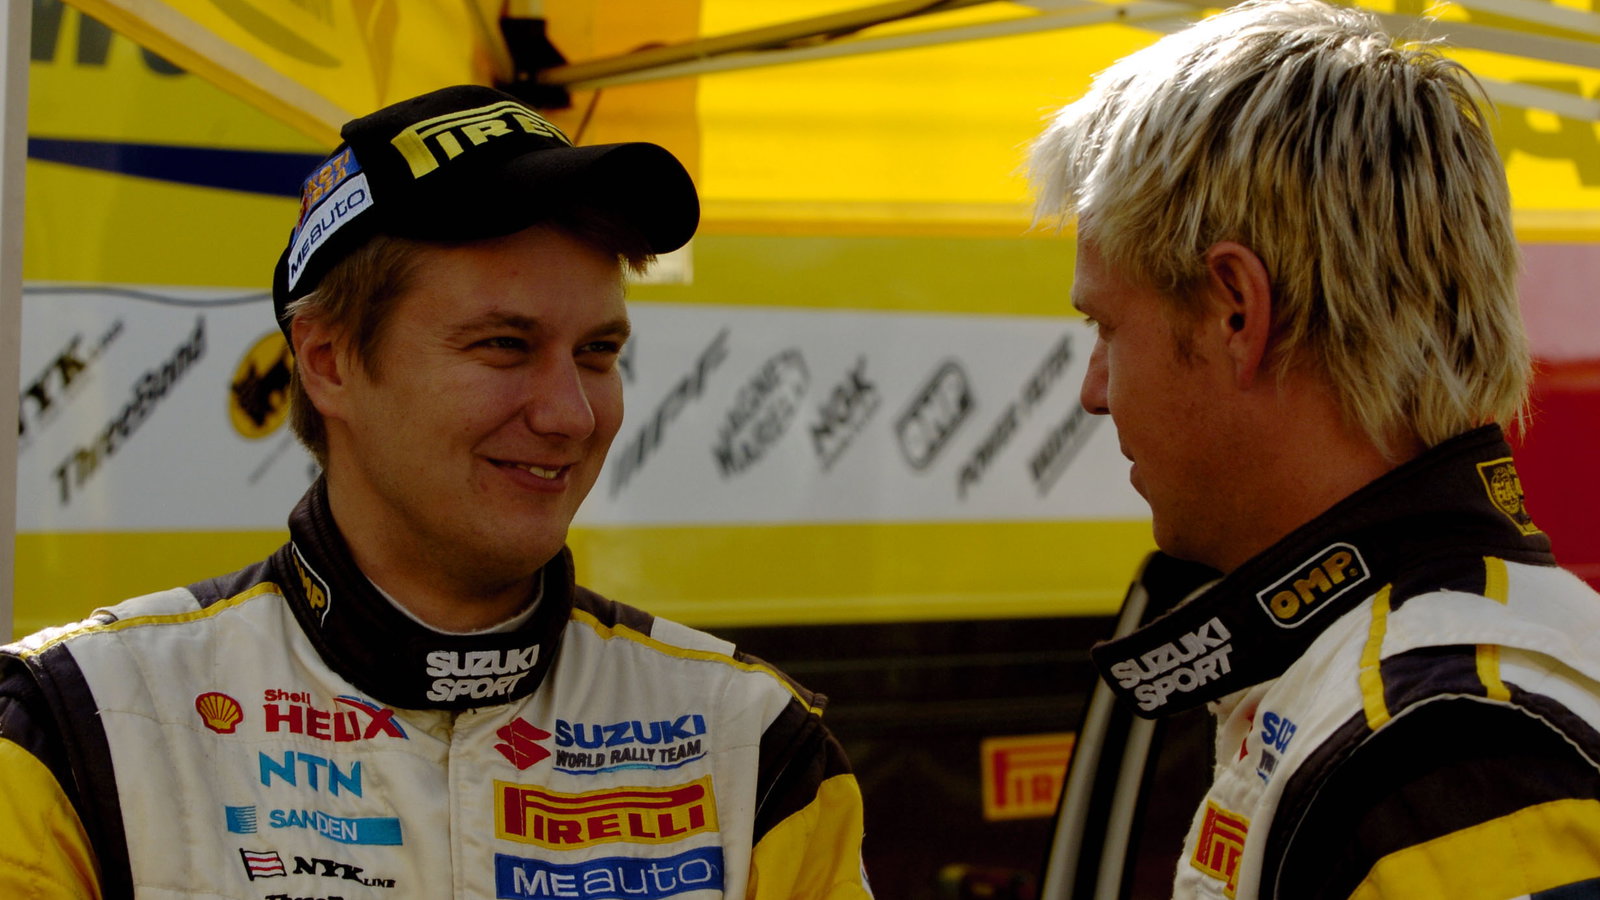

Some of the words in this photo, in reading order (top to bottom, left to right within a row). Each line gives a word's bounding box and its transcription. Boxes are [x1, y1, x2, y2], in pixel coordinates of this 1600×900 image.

[390, 101, 574, 179] PIRE
[426, 644, 540, 678] SUZUKI
[1110, 616, 1232, 690] SUZUKI
[426, 672, 530, 701] SPORT
[1134, 643, 1233, 712] SPORT
[264, 689, 311, 704] Shell
[263, 696, 405, 743] HELIX
[555, 715, 706, 749] SUZUKI
[555, 749, 605, 768] WORLD
[610, 746, 654, 765] RALLY
[658, 739, 702, 763] TEAM
[259, 751, 363, 798] NTN
[270, 809, 358, 841] SANDEN
[504, 785, 705, 844] PIRELLI
[293, 856, 366, 884] NYK
[363, 878, 397, 888] LINE
[513, 858, 712, 897] MEauto
